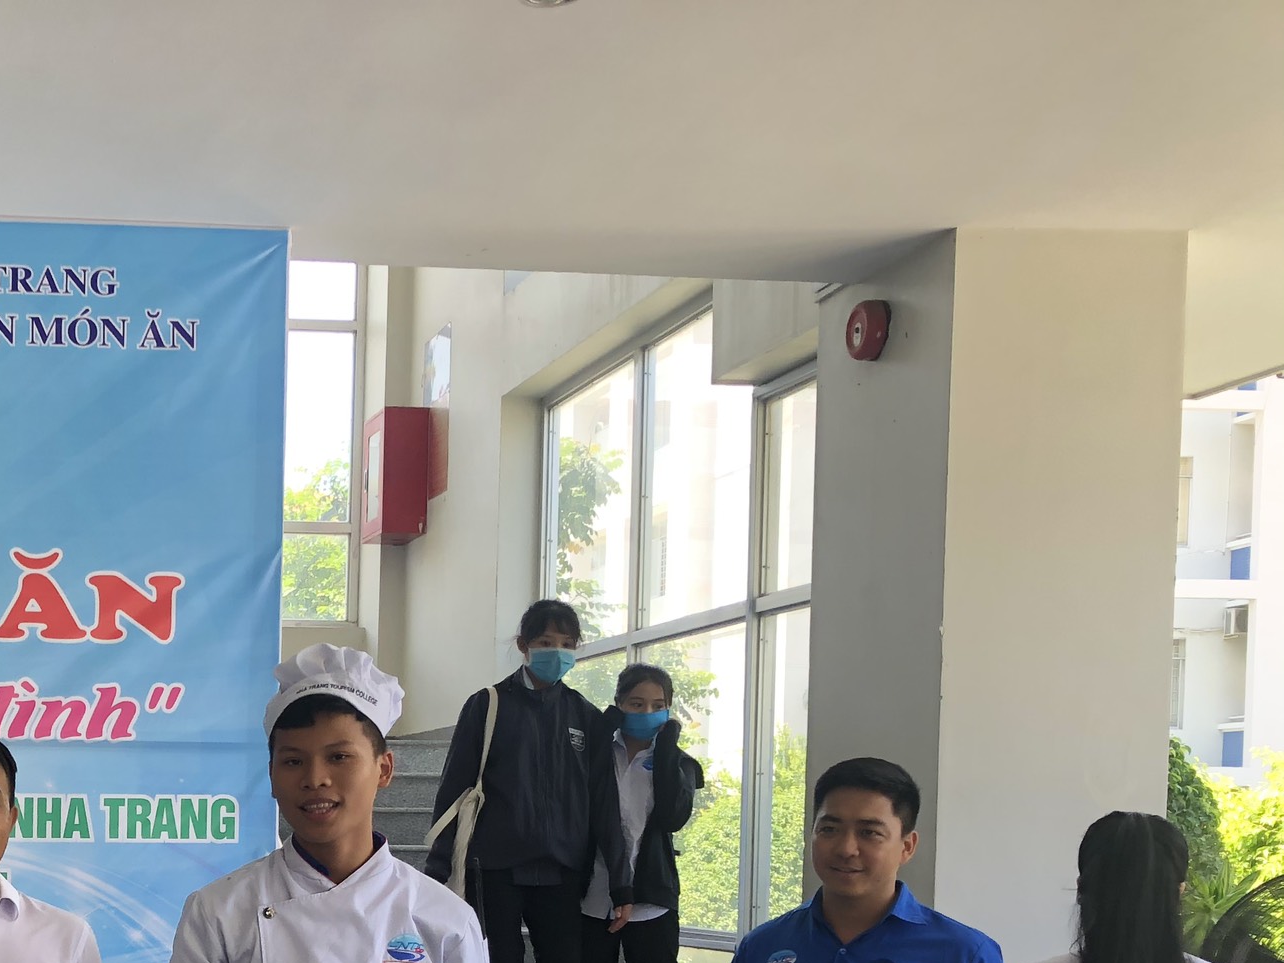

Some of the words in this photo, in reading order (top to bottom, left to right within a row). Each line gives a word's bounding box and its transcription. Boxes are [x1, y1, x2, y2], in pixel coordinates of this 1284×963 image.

[27, 308, 129, 349] MÓN
[138, 310, 199, 351] ĂN
[308, 683, 329, 691] TRANG
[330, 683, 355, 694] TOURISM
[355, 690, 378, 706] COLLEGE
[15, 796, 92, 840] NHA
[102, 797, 238, 842] TRANG
